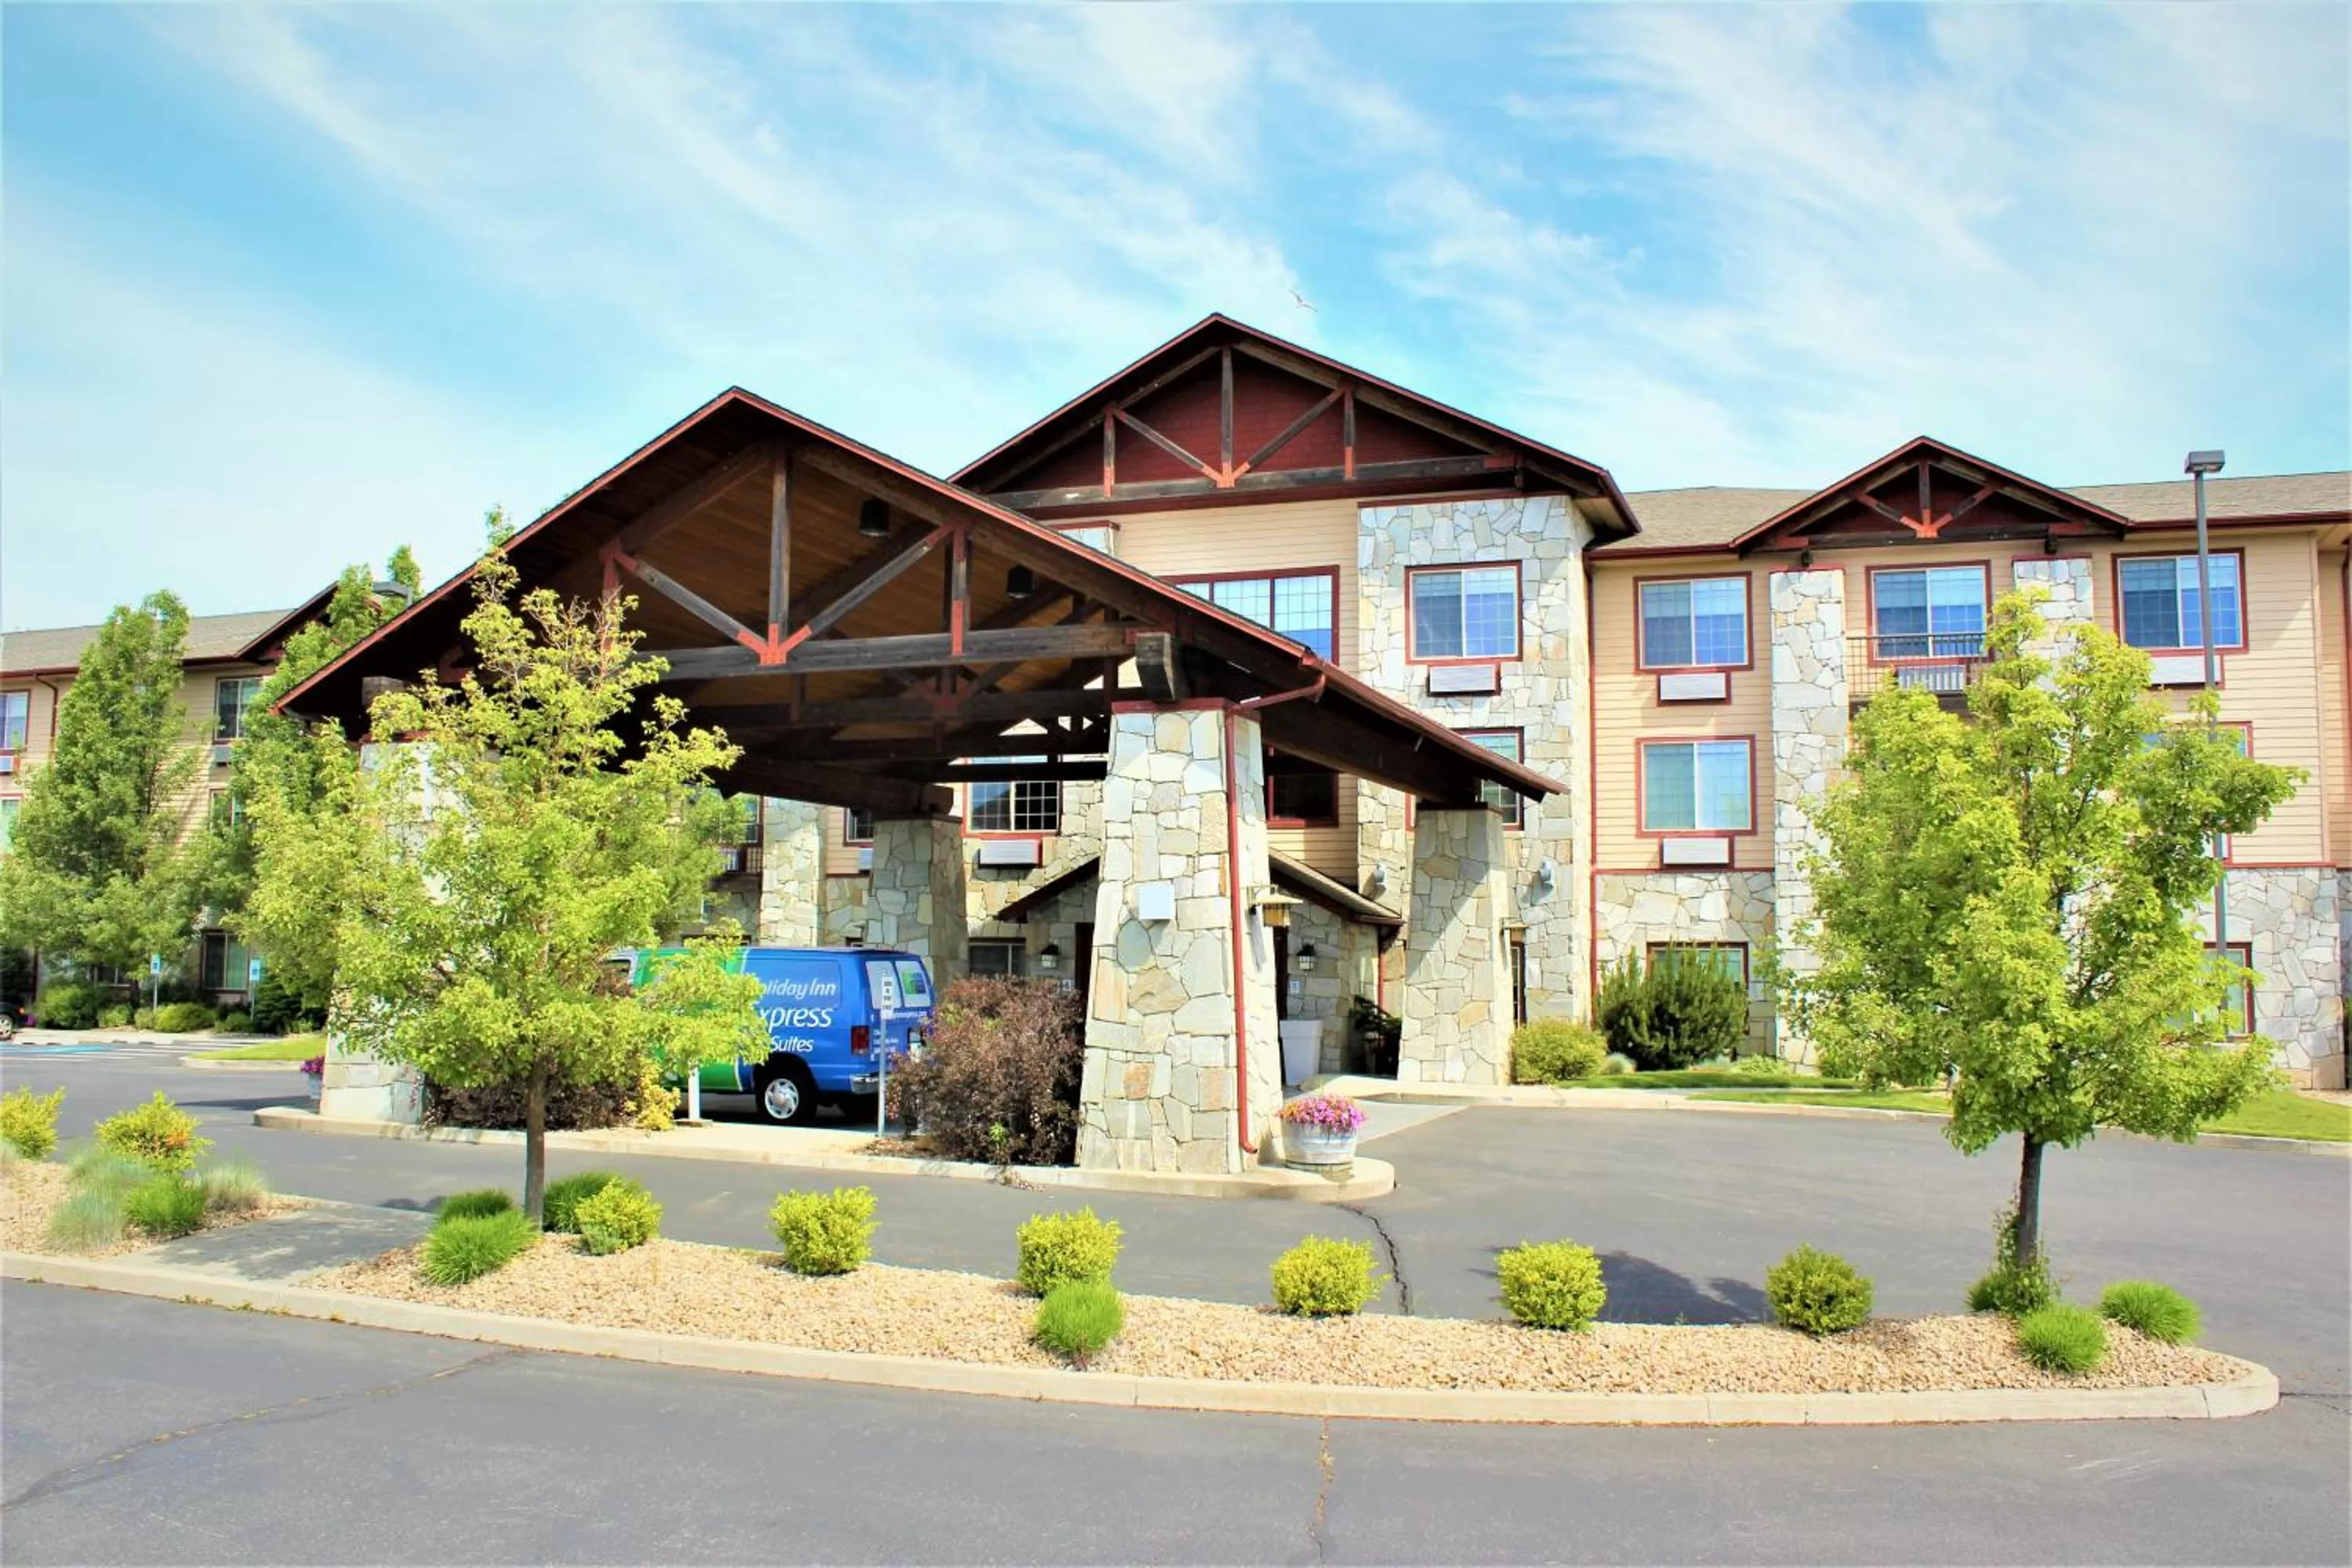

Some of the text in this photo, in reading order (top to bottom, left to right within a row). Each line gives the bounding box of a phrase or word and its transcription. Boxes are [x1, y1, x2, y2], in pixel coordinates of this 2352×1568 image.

[760, 978, 836, 1000] oliday Inn
[760, 1007, 833, 1033] xpress
[771, 1036, 815, 1052] Suites
